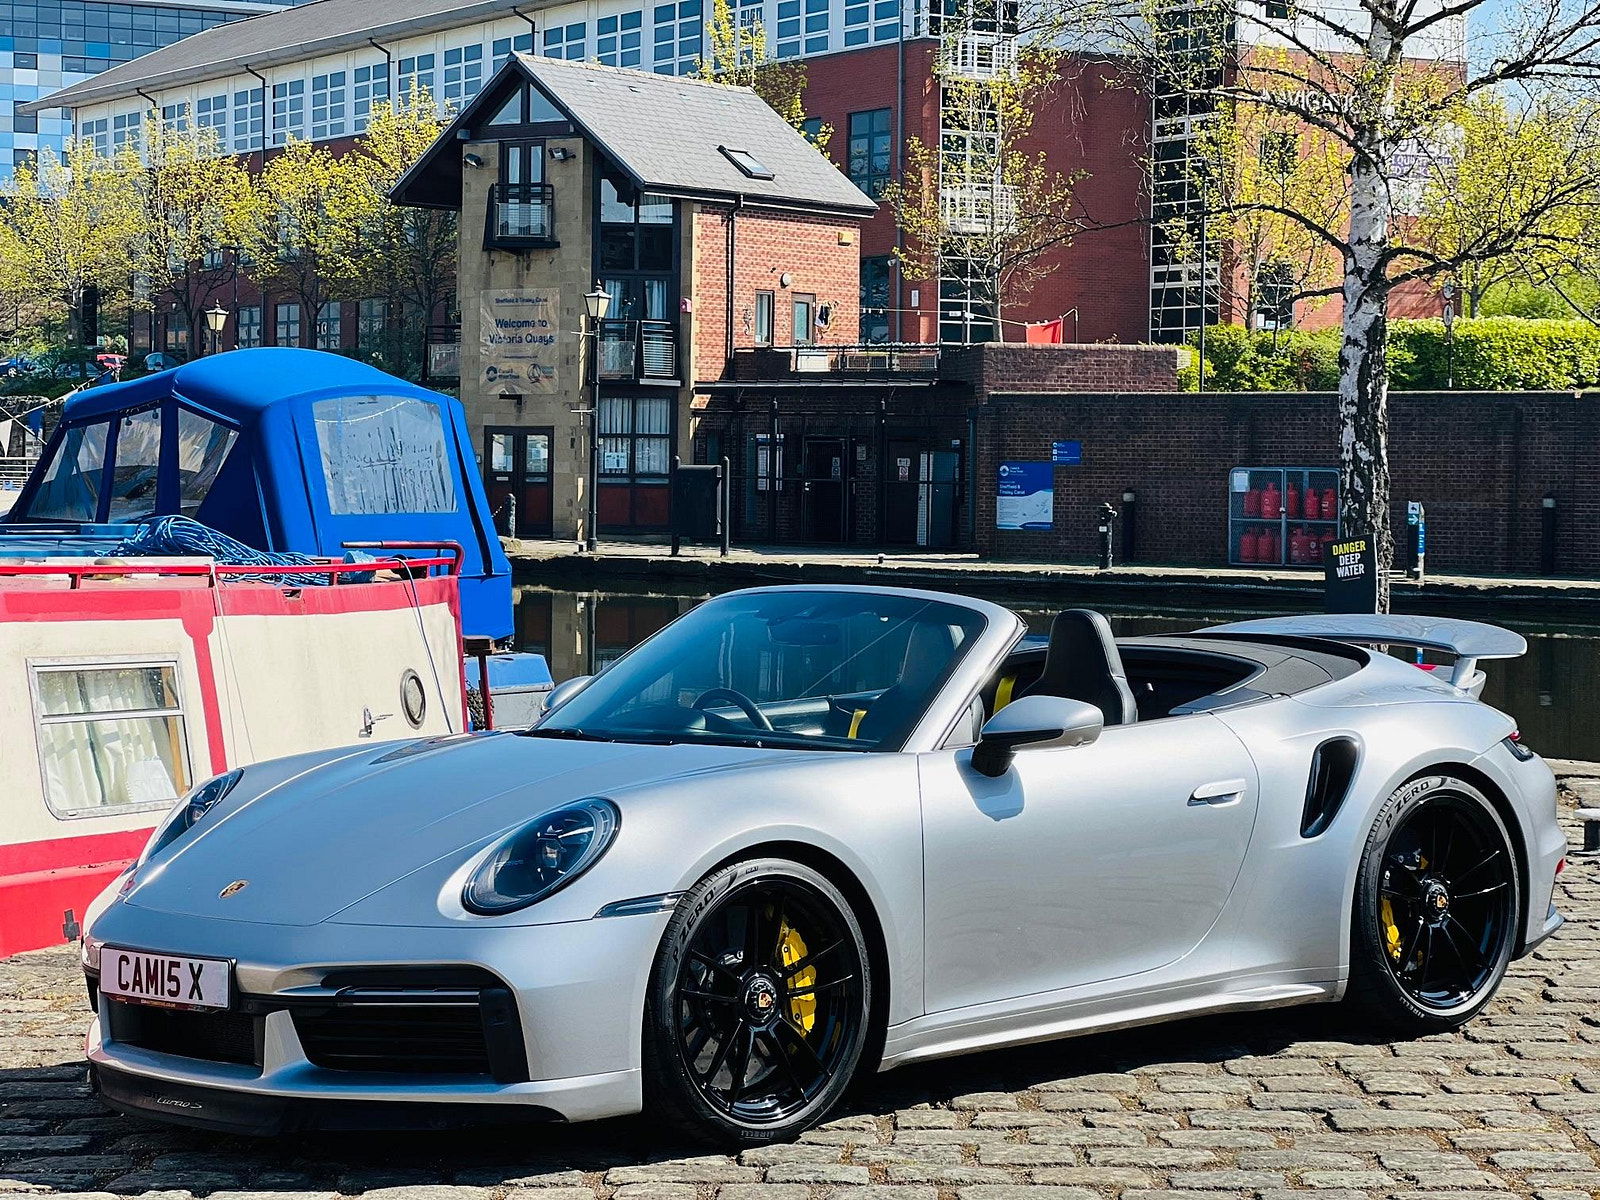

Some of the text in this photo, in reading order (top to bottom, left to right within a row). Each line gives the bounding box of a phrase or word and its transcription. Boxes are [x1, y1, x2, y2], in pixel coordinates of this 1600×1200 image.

[495, 319, 548, 328] Welcome to
[489, 334, 554, 345] Victoria Quays
[1332, 540, 1366, 555] DANGER
[1339, 553, 1361, 566] DEEP
[1336, 563, 1365, 578] WATER
[1386, 781, 1429, 828] P ZERO
[680, 889, 715, 944] ZERO
[188, 962, 204, 1001] X
